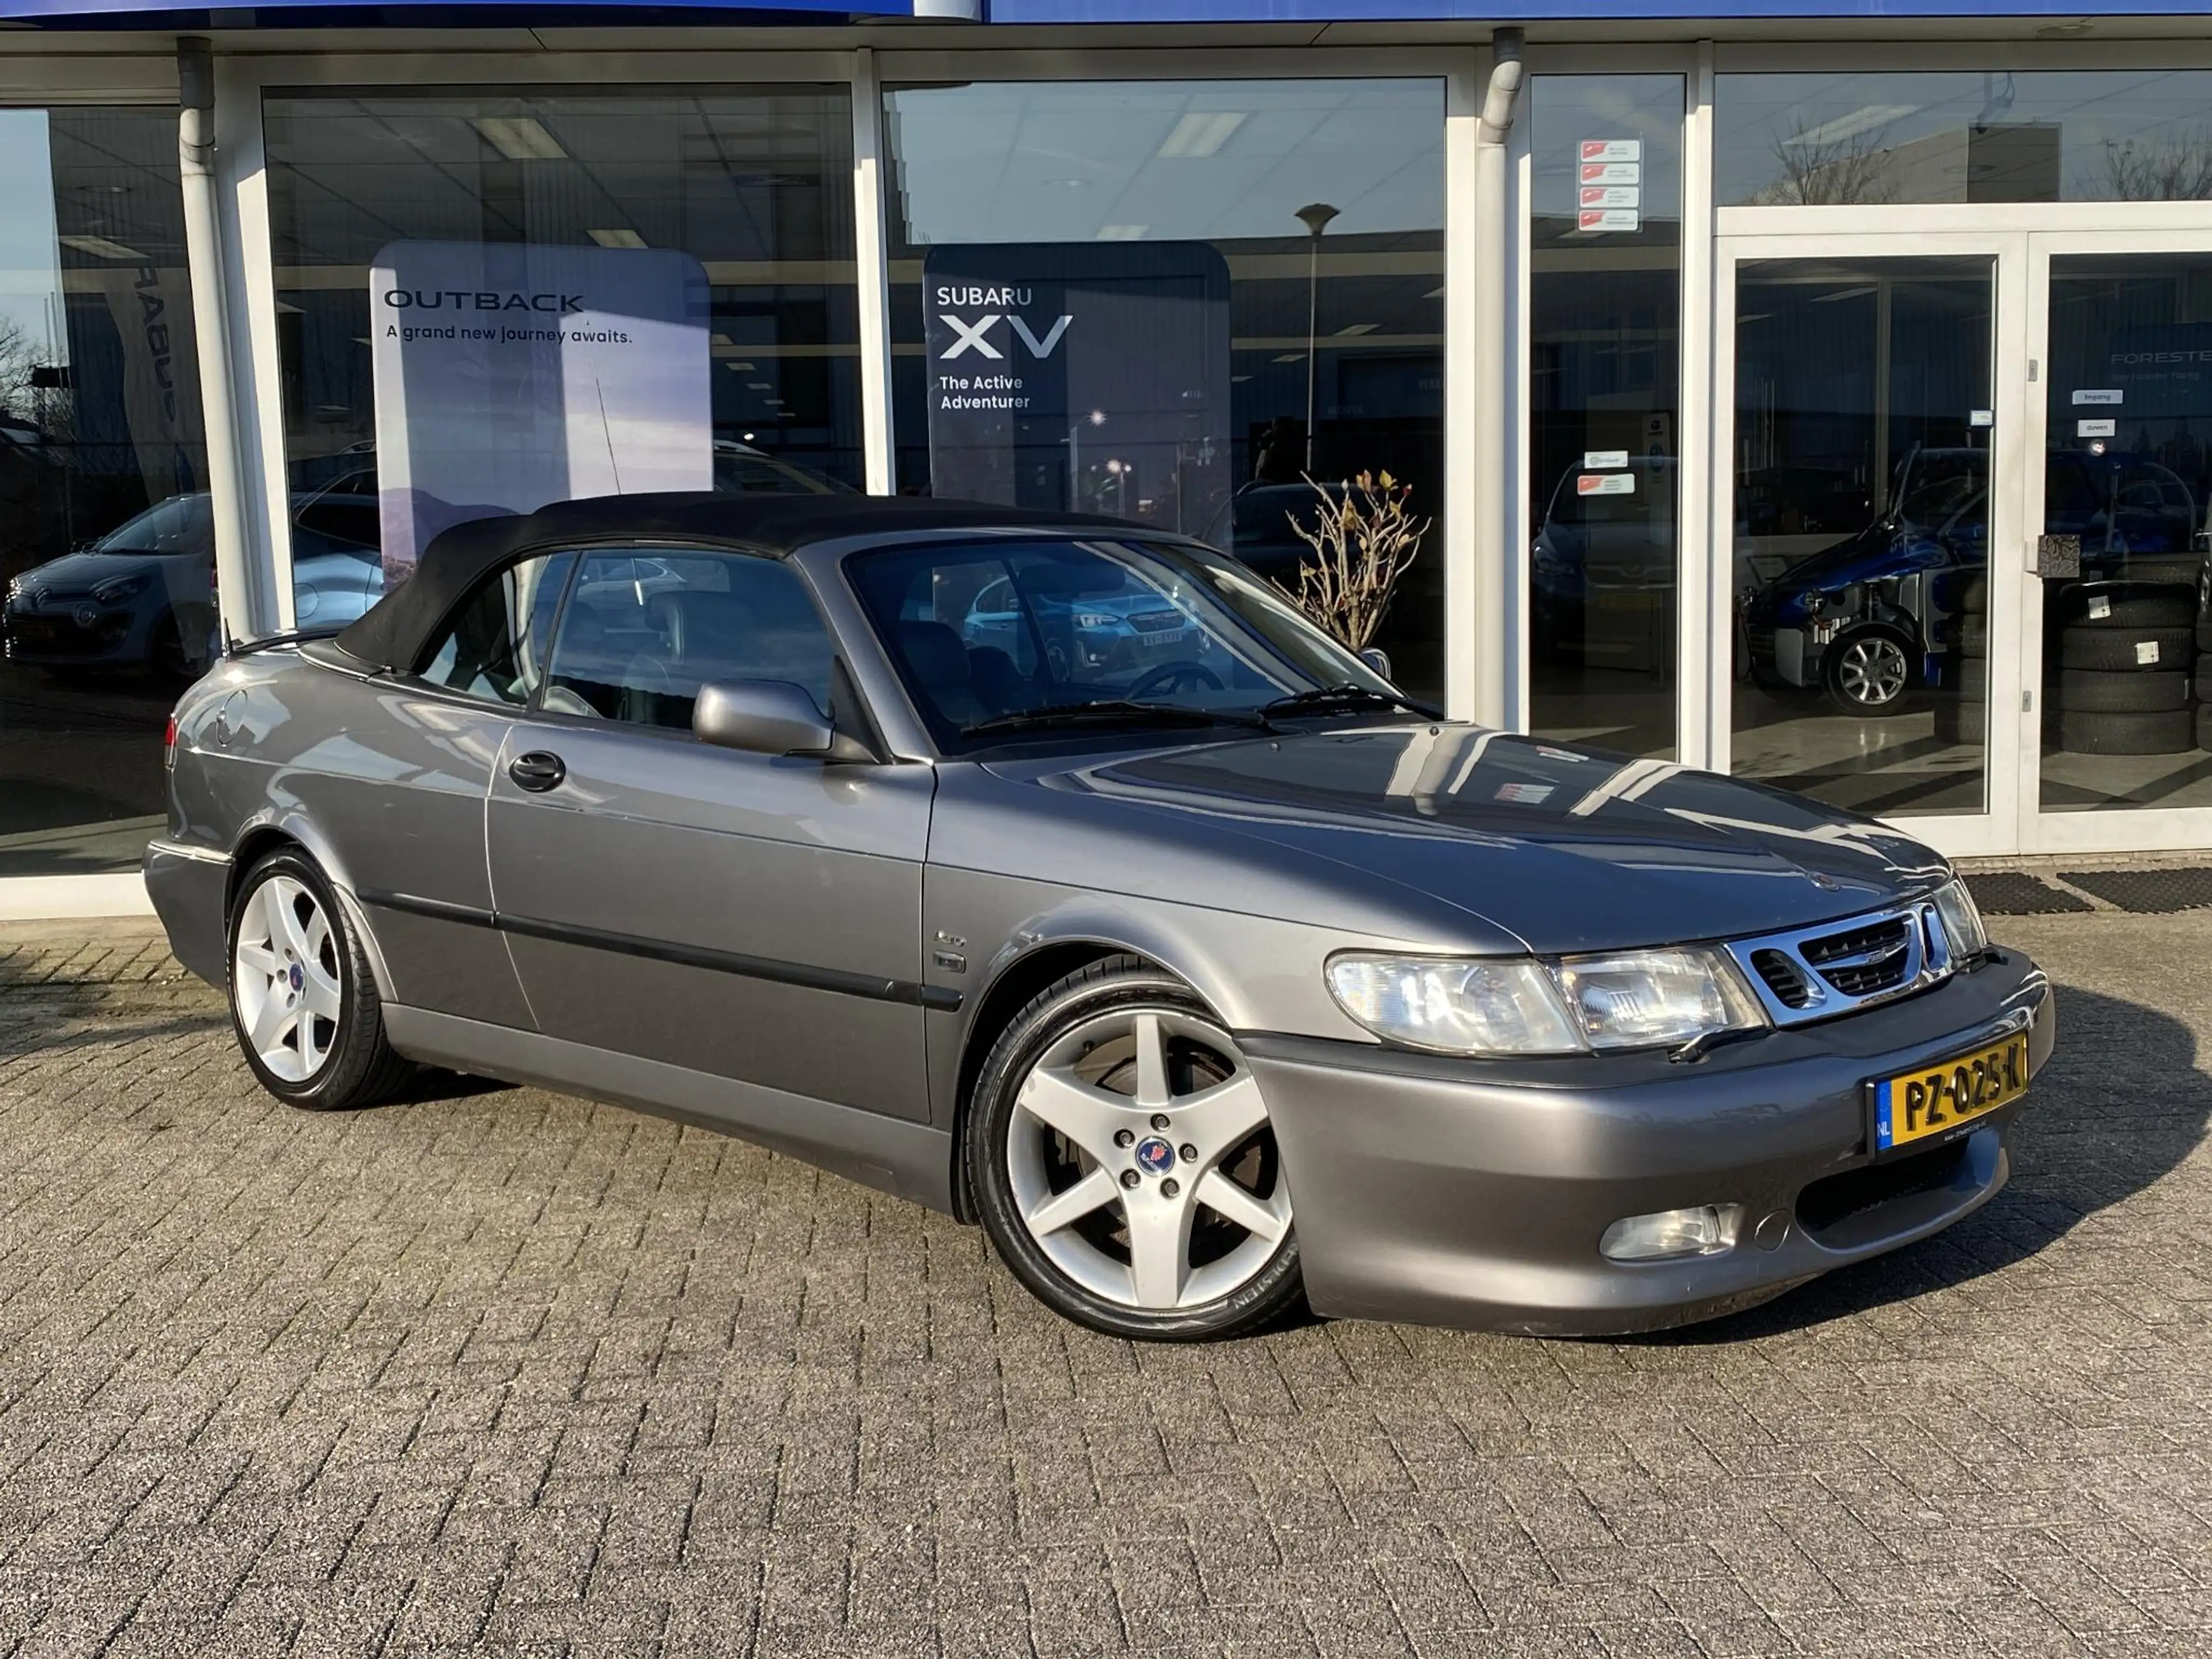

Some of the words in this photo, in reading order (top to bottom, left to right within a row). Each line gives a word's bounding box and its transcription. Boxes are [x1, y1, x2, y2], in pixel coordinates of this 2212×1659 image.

[384, 290, 585, 312] OUTBACK
[937, 287, 1032, 306] SUBARU
[387, 325, 397, 338] A
[403, 325, 456, 342] grand
[461, 329, 496, 340] new
[500, 327, 566, 344] journey
[571, 328, 633, 344] awaits.
[940, 315, 1073, 359] XV
[940, 376, 969, 389] The
[974, 375, 1022, 389] Active
[941, 396, 1030, 410] Adventurer
[1906, 1043, 2020, 1131] PZ-025-K
[1877, 1121, 1891, 1138] NL
